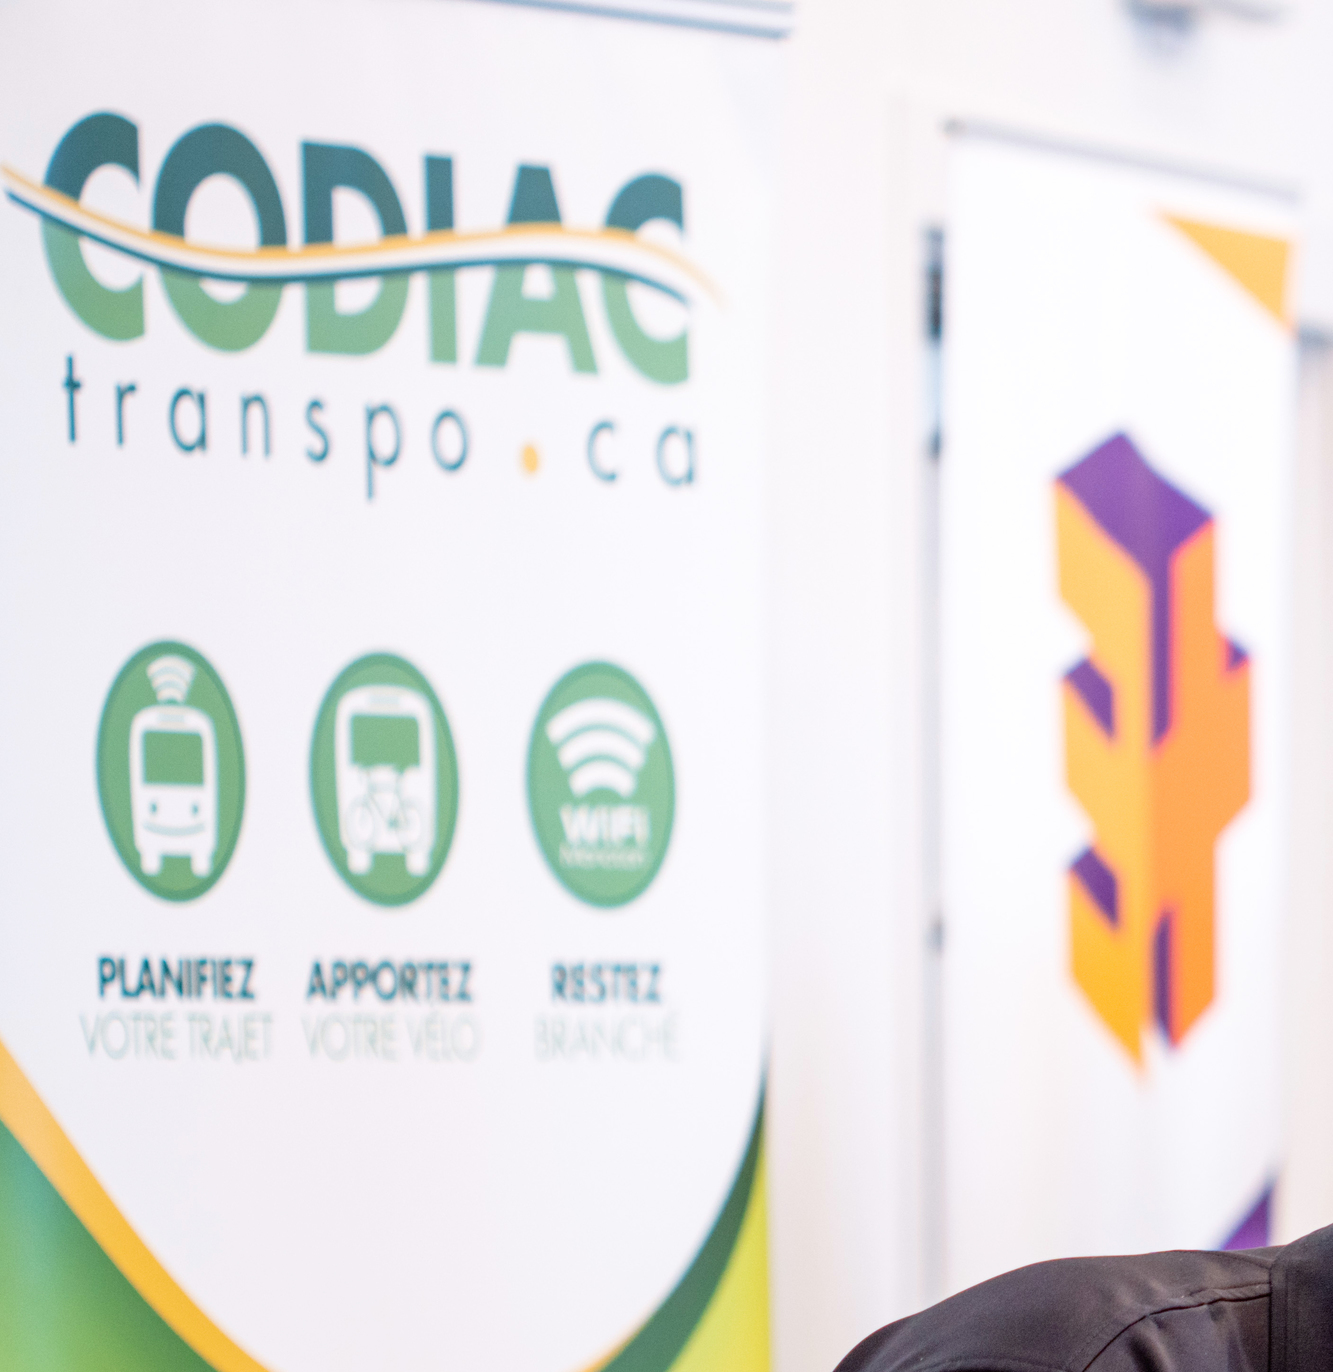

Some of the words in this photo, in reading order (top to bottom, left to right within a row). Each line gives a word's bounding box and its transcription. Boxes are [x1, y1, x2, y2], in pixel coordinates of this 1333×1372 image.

[42, 110, 690, 385] CODIAC
[97, 956, 255, 1001] PLANIFIEZ
[306, 958, 474, 1003] APPORTEZ
[551, 961, 661, 1004] RESTEZ
[79, 1010, 177, 1060] VOTRE
[187, 1011, 274, 1064] TRAJET
[300, 1012, 398, 1062] VOTRE
